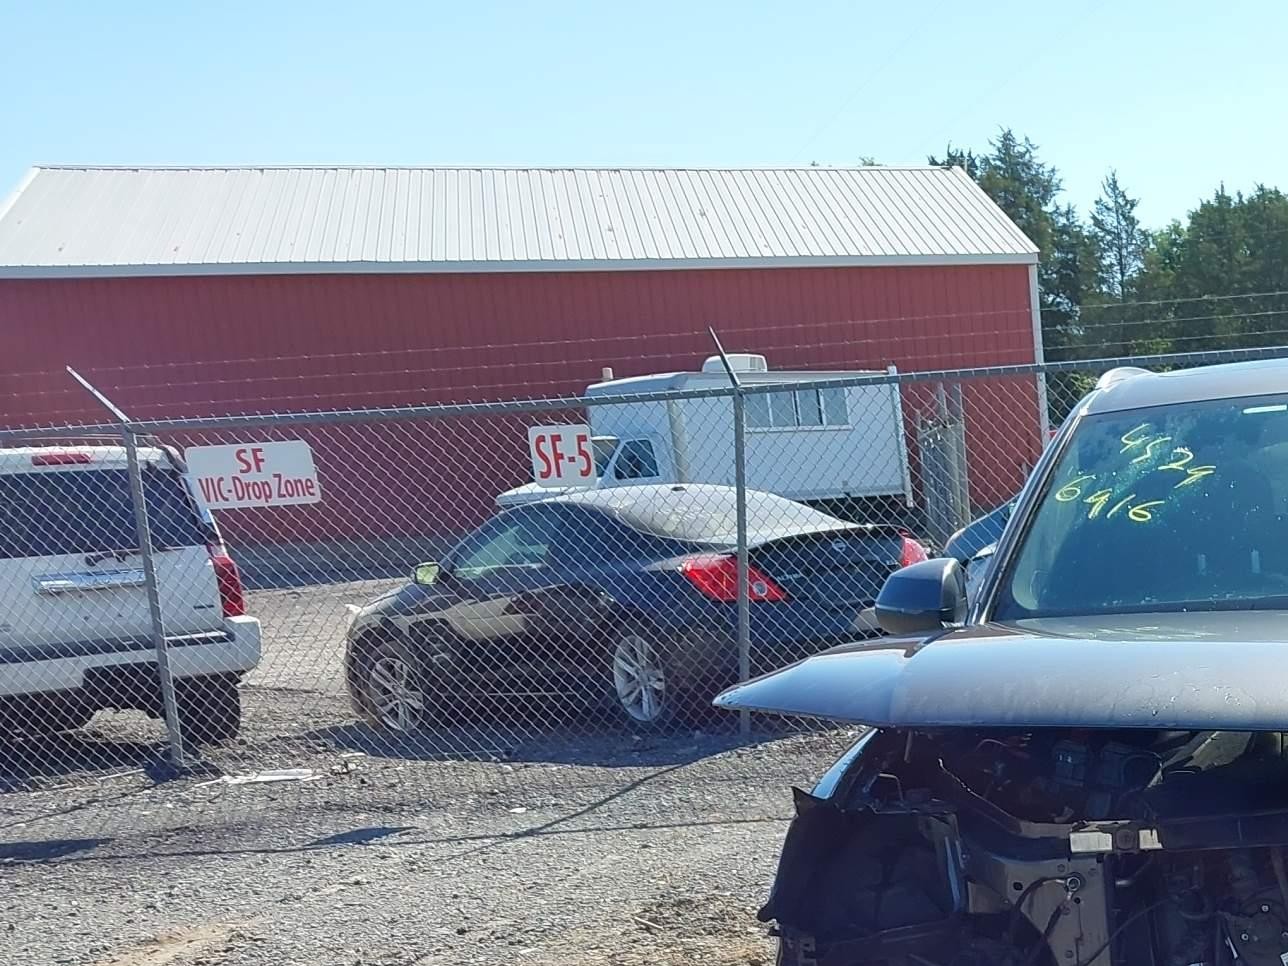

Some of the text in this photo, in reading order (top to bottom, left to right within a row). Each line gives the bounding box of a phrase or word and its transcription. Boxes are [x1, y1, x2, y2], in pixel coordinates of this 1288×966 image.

[235, 448, 265, 474] SF
[535, 434, 592, 479] SF-5
[198, 473, 316, 503] VIC-Drop Zone
